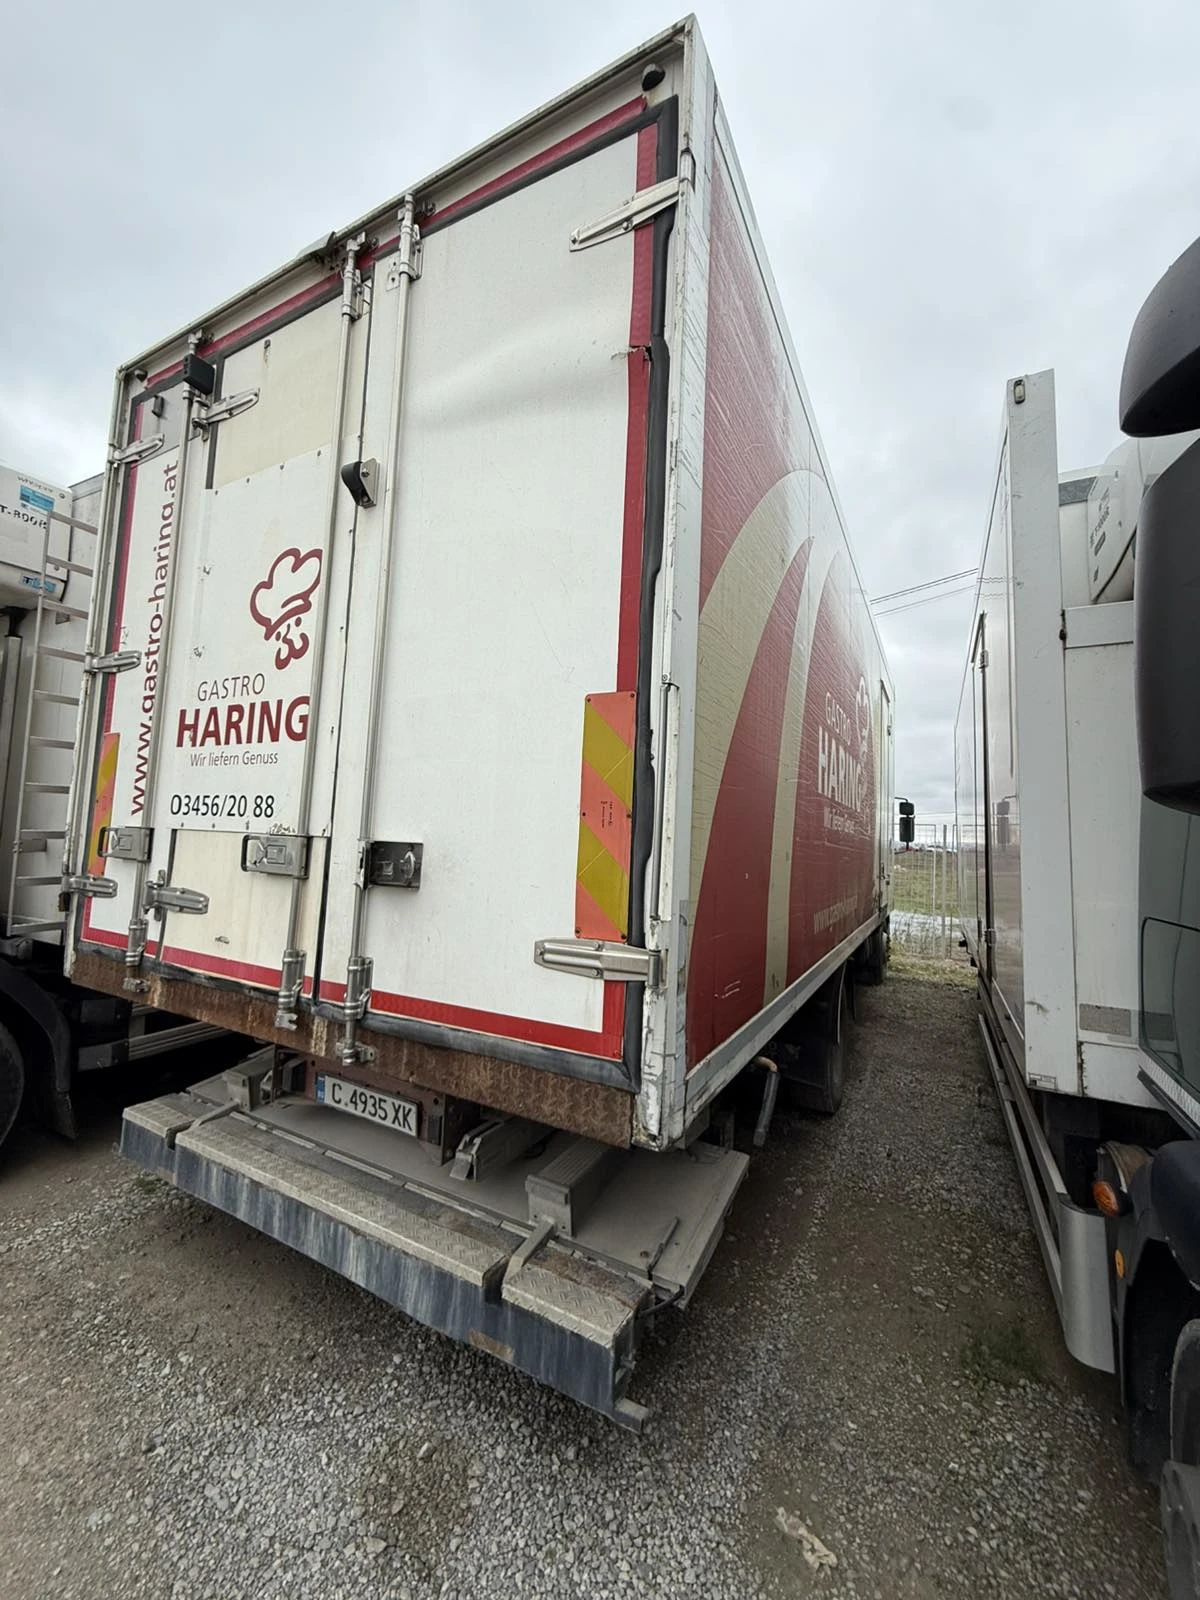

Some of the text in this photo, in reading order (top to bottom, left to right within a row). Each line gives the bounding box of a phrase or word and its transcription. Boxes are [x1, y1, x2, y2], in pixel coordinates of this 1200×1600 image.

[197, 672, 265, 702] GASTRO
[176, 695, 311, 749] HARING
[825, 691, 851, 746] GASTRO
[190, 750, 279, 767] Wir liefern Genuss
[818, 726, 862, 812] HARING
[253, 795, 275, 818] 88
